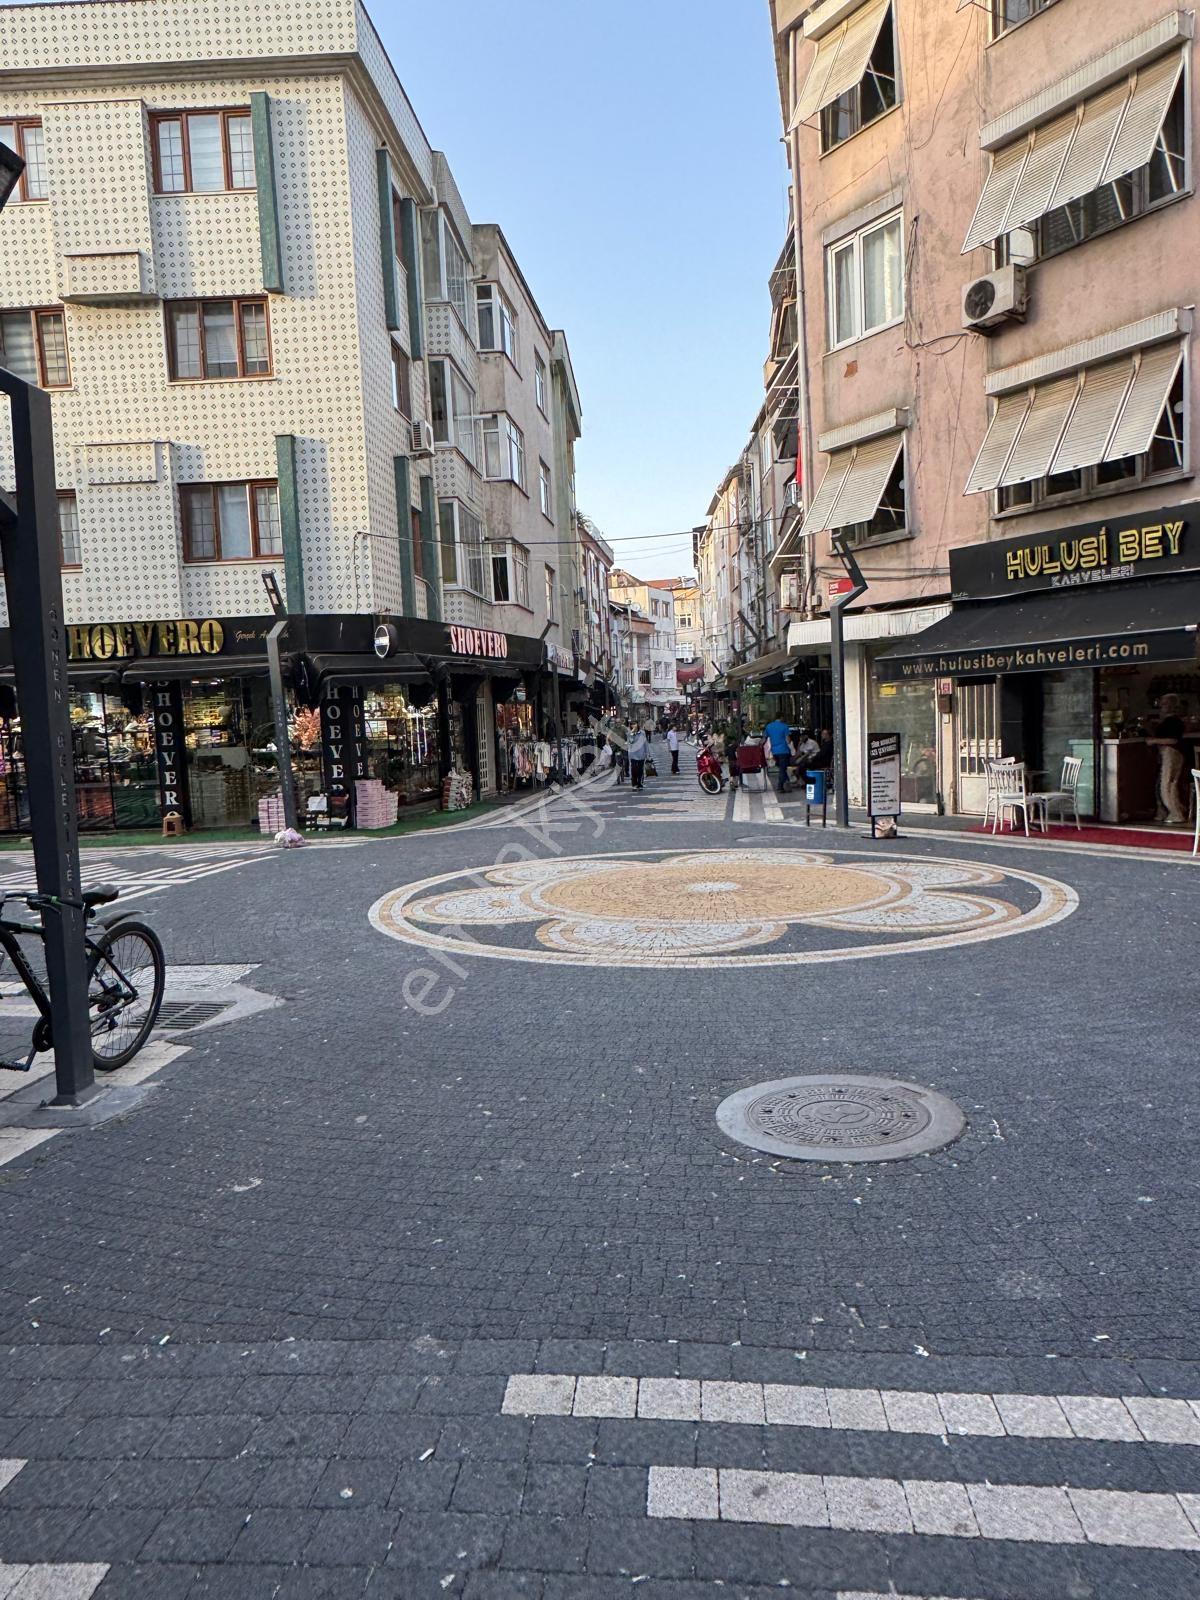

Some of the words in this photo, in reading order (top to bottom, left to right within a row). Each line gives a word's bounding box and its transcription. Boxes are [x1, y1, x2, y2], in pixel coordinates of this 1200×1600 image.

[1007, 526, 1108, 580] HULUSİ
[1119, 520, 1185, 563] BEY
[1051, 564, 1136, 587] KAHVELERİ
[66, 619, 224, 660] HOEVERO
[450, 625, 508, 659] SHOEVERO
[902, 641, 1149, 675] www.hulusibeykahveleri.com
